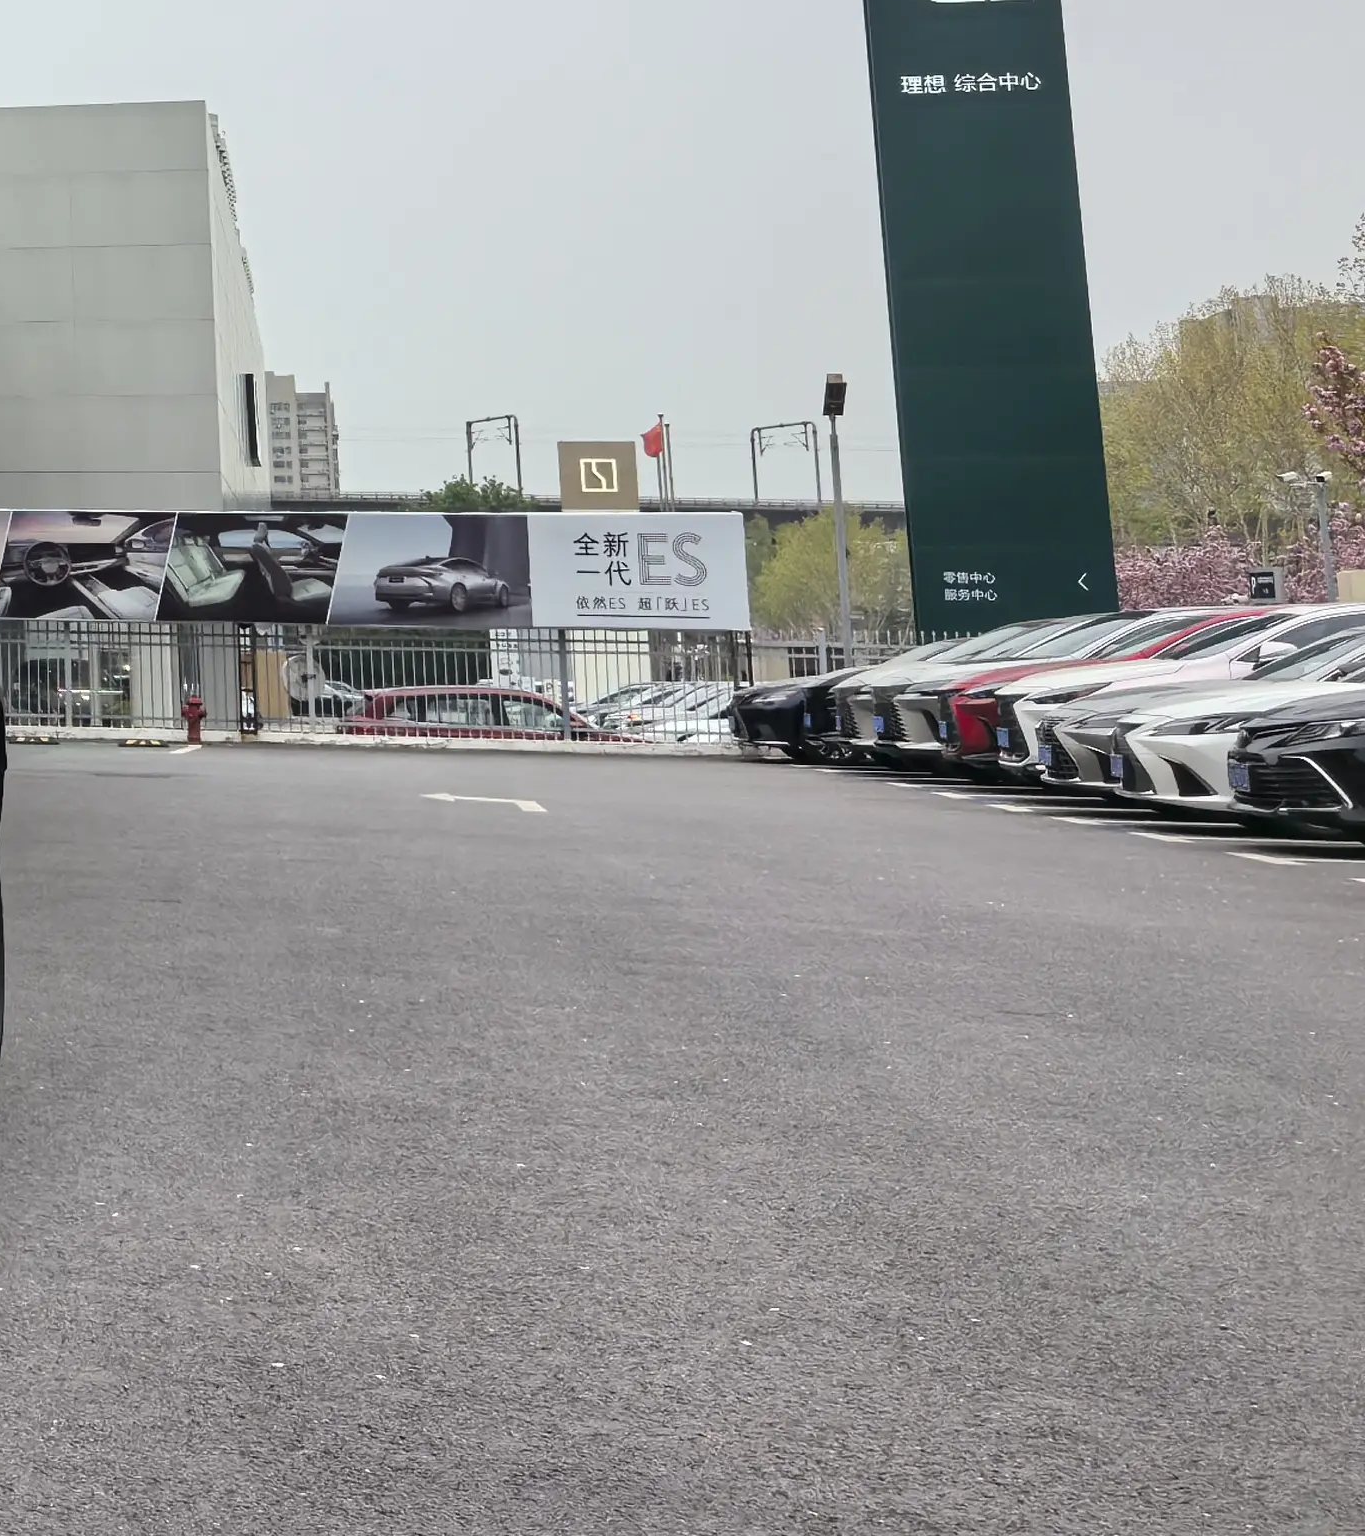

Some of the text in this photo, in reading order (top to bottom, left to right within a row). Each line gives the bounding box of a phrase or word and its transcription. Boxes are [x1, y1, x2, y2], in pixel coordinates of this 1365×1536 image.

[900, 72, 1042, 94] 理想 综合中心
[573, 532, 707, 586] 全新 ES
[576, 560, 632, 586] 一代
[943, 571, 996, 584] 零售中心
[576, 596, 710, 611] 依然ES 超「跃」ES
[944, 588, 998, 601] 服务中心
